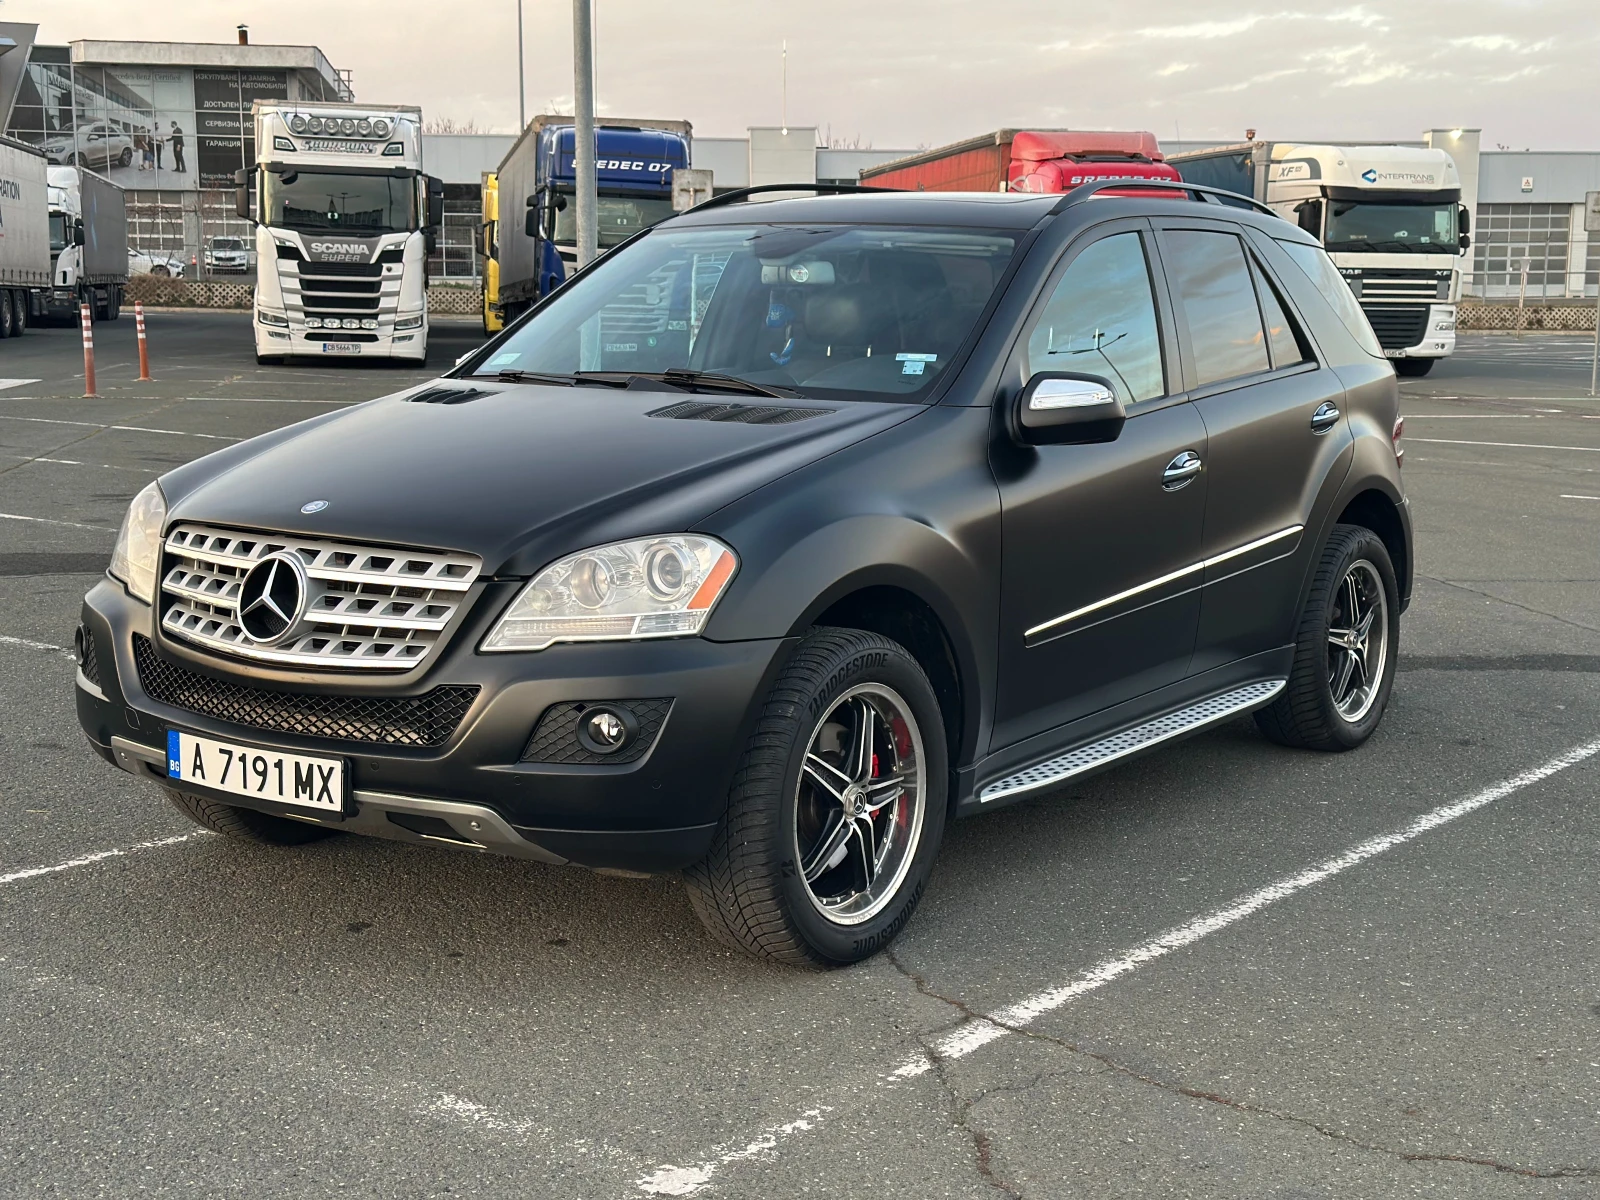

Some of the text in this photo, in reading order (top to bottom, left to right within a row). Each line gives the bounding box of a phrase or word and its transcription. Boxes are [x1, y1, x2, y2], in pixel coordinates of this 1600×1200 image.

[195, 73, 238, 81] ИЗКУПУВАНЕ
[203, 100, 239, 109] ДОСТЪПЕН
[205, 120, 240, 128] СЕРВИЗНА
[206, 139, 241, 148] ГАРАНЦИЯ
[571, 159, 672, 173] EDEC 07
[1278, 166, 1295, 178] XF
[1378, 173, 1434, 181] INTERTRANS
[310, 242, 370, 255] SCANIA
[321, 254, 360, 262] SUPER
[808, 652, 889, 718] BRIDGESTONE
[169, 759, 180, 772] BG
[191, 742, 336, 804] A 7191 MX
